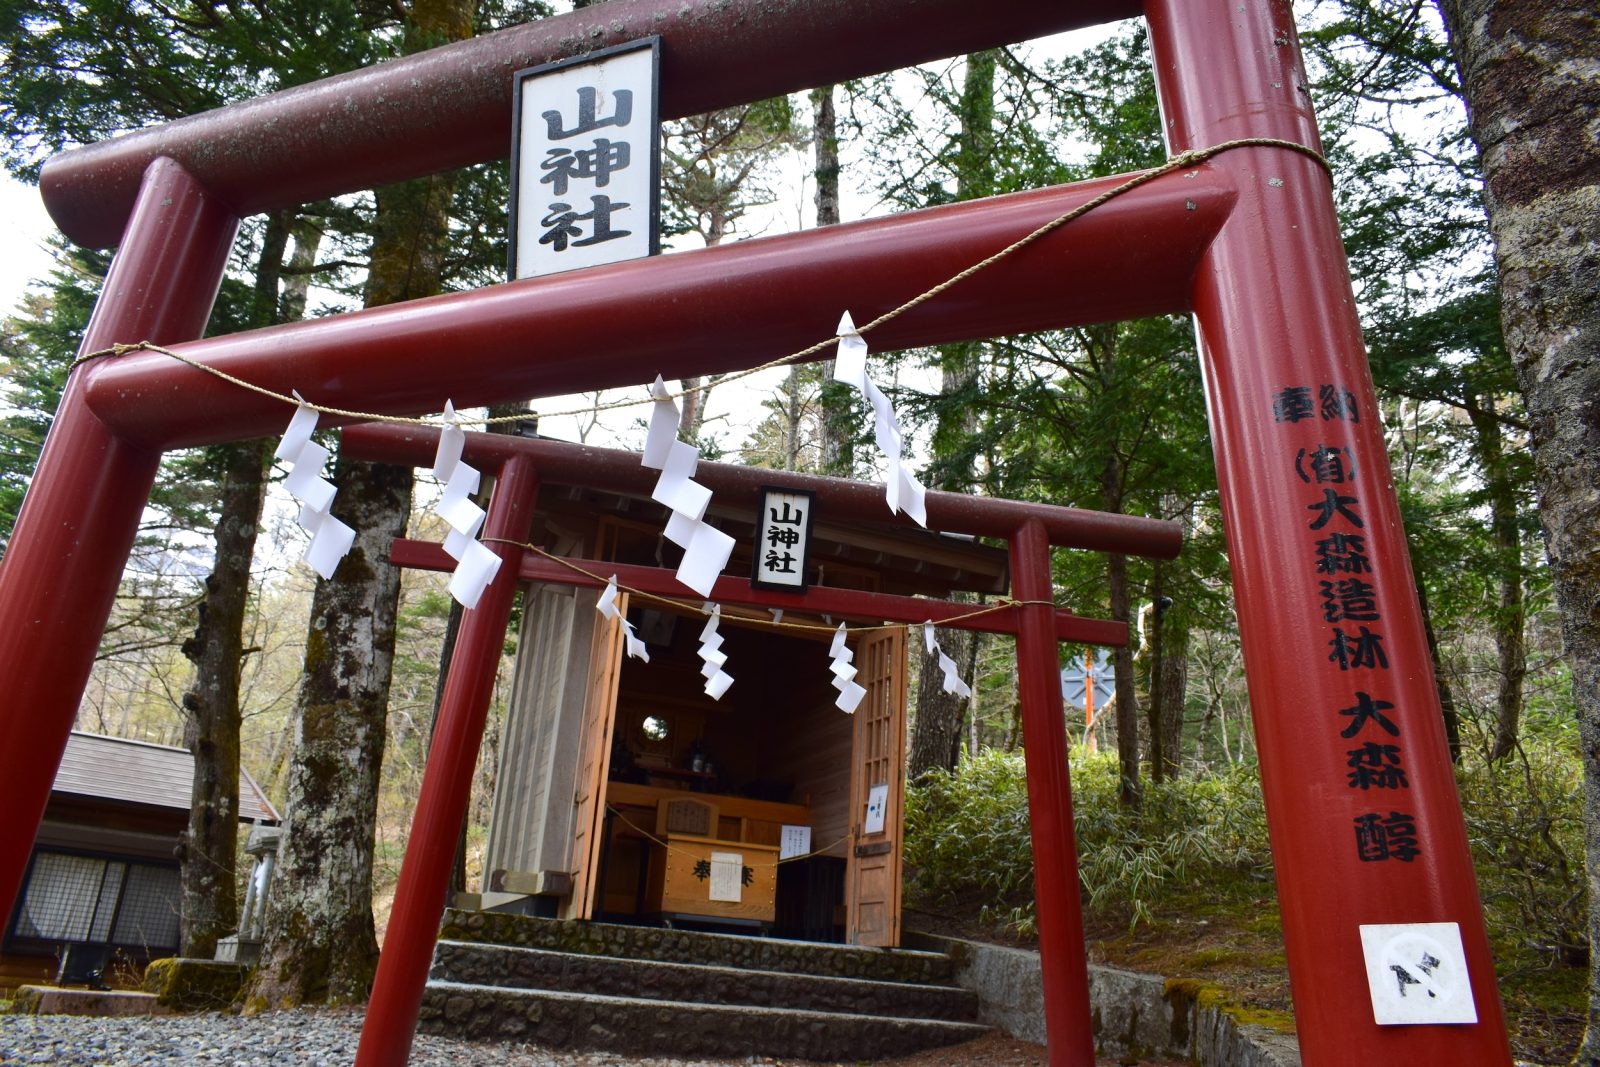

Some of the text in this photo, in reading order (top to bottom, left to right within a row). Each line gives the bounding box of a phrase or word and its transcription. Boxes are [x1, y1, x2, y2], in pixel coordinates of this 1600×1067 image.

[539, 86, 633, 252] 山神社
[764, 502, 803, 574] 山神社
